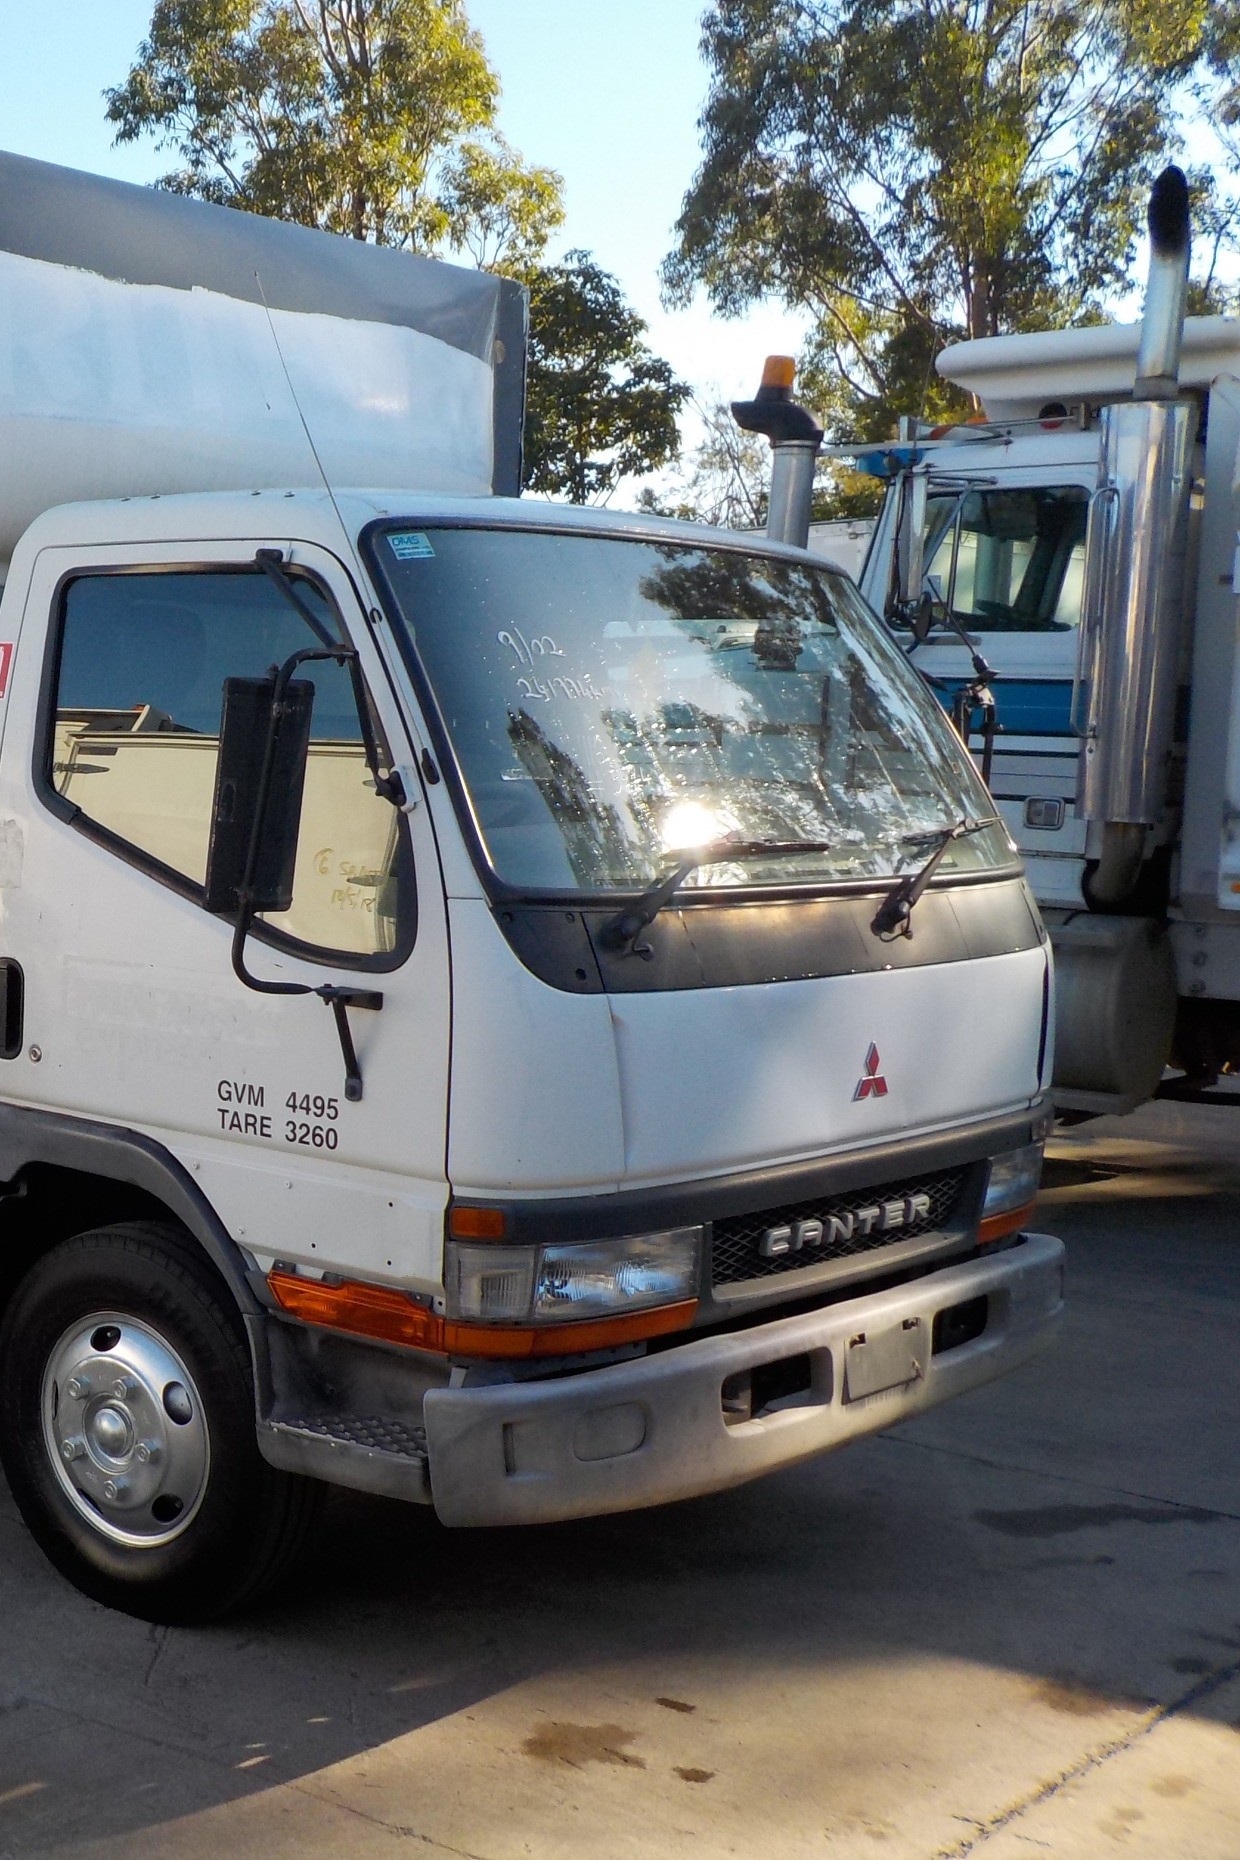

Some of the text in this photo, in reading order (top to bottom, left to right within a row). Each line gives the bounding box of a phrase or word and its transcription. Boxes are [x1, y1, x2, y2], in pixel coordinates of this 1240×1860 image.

[217, 1079, 339, 1121] GVM 4495
[216, 1107, 339, 1151] TARE 3260
[760, 1192, 932, 1258] CANTER
